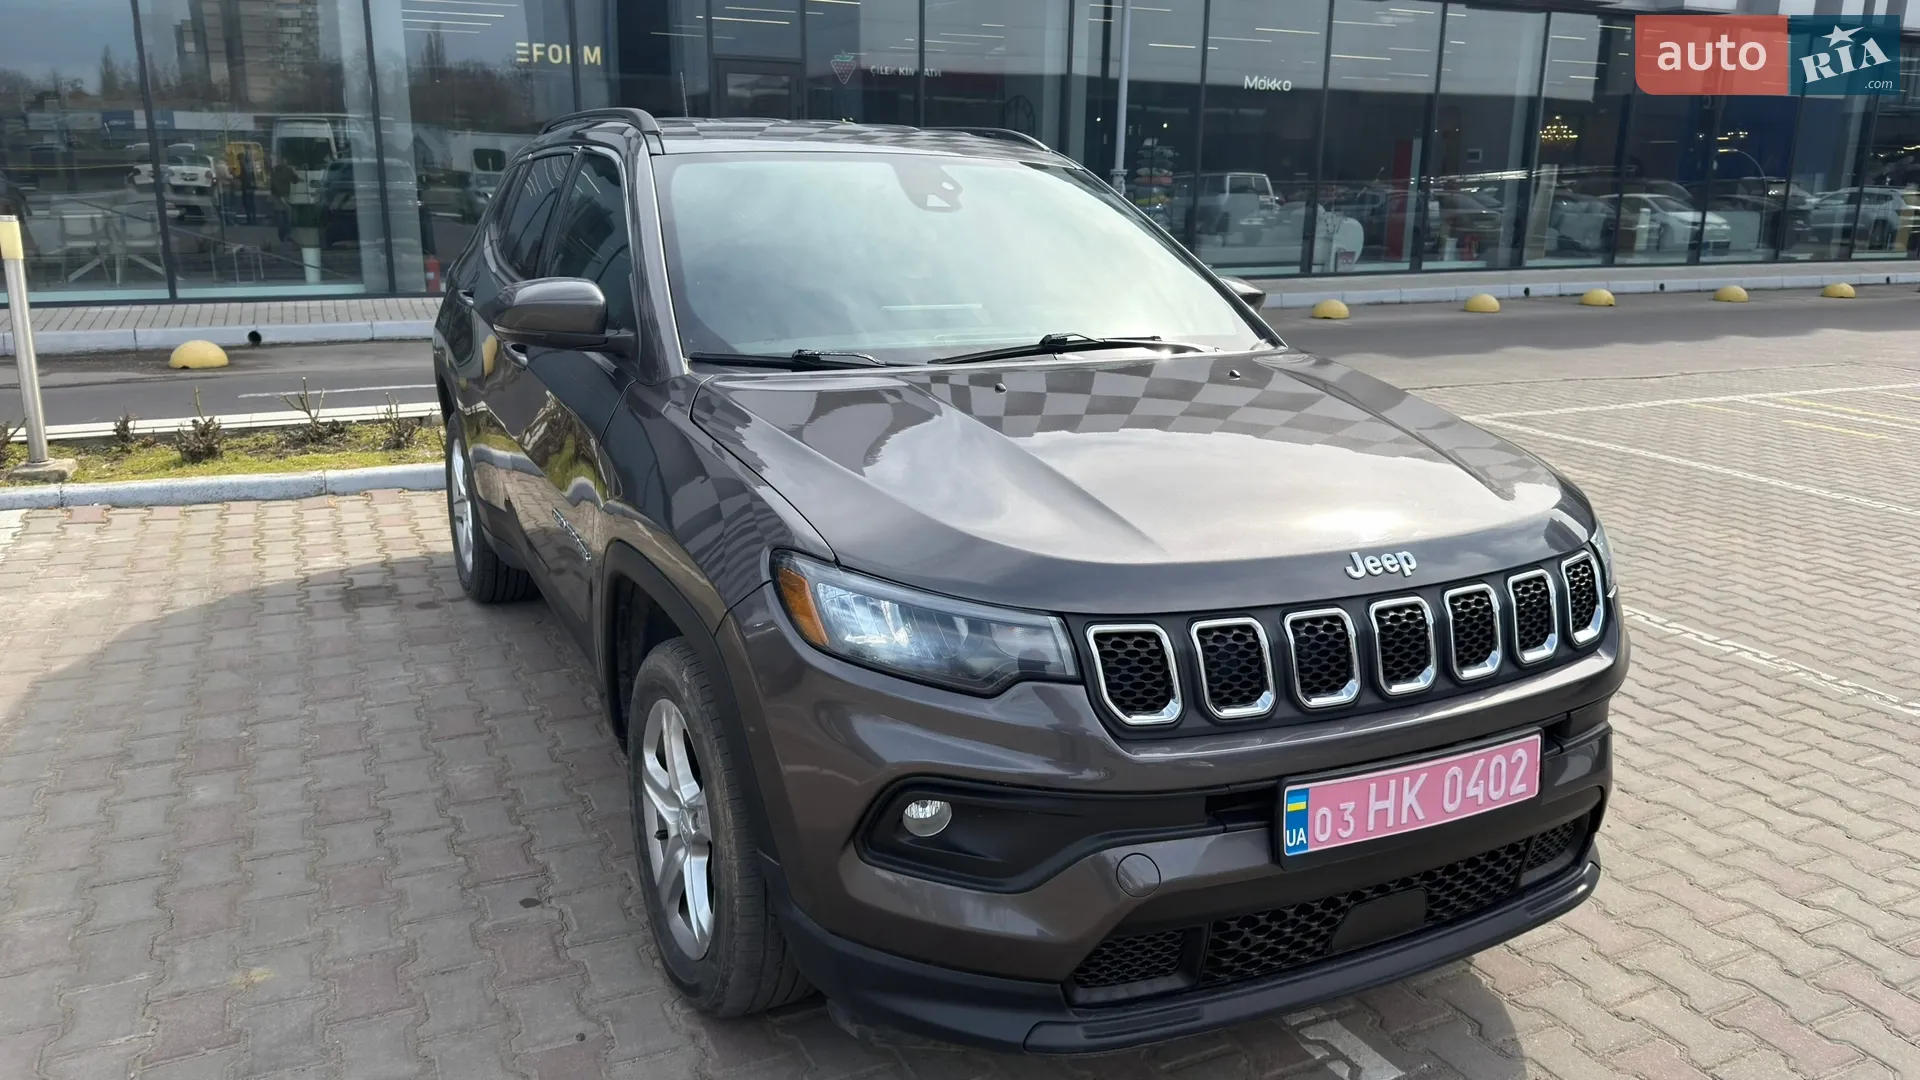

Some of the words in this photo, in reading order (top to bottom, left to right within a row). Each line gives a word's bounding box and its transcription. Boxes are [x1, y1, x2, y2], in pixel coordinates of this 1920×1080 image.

[1344, 550, 1417, 579] Jeep
[1314, 801, 1356, 843] 03
[1367, 772, 1428, 831] HK
[1442, 748, 1528, 813] 0402
[1286, 828, 1307, 847] UA
